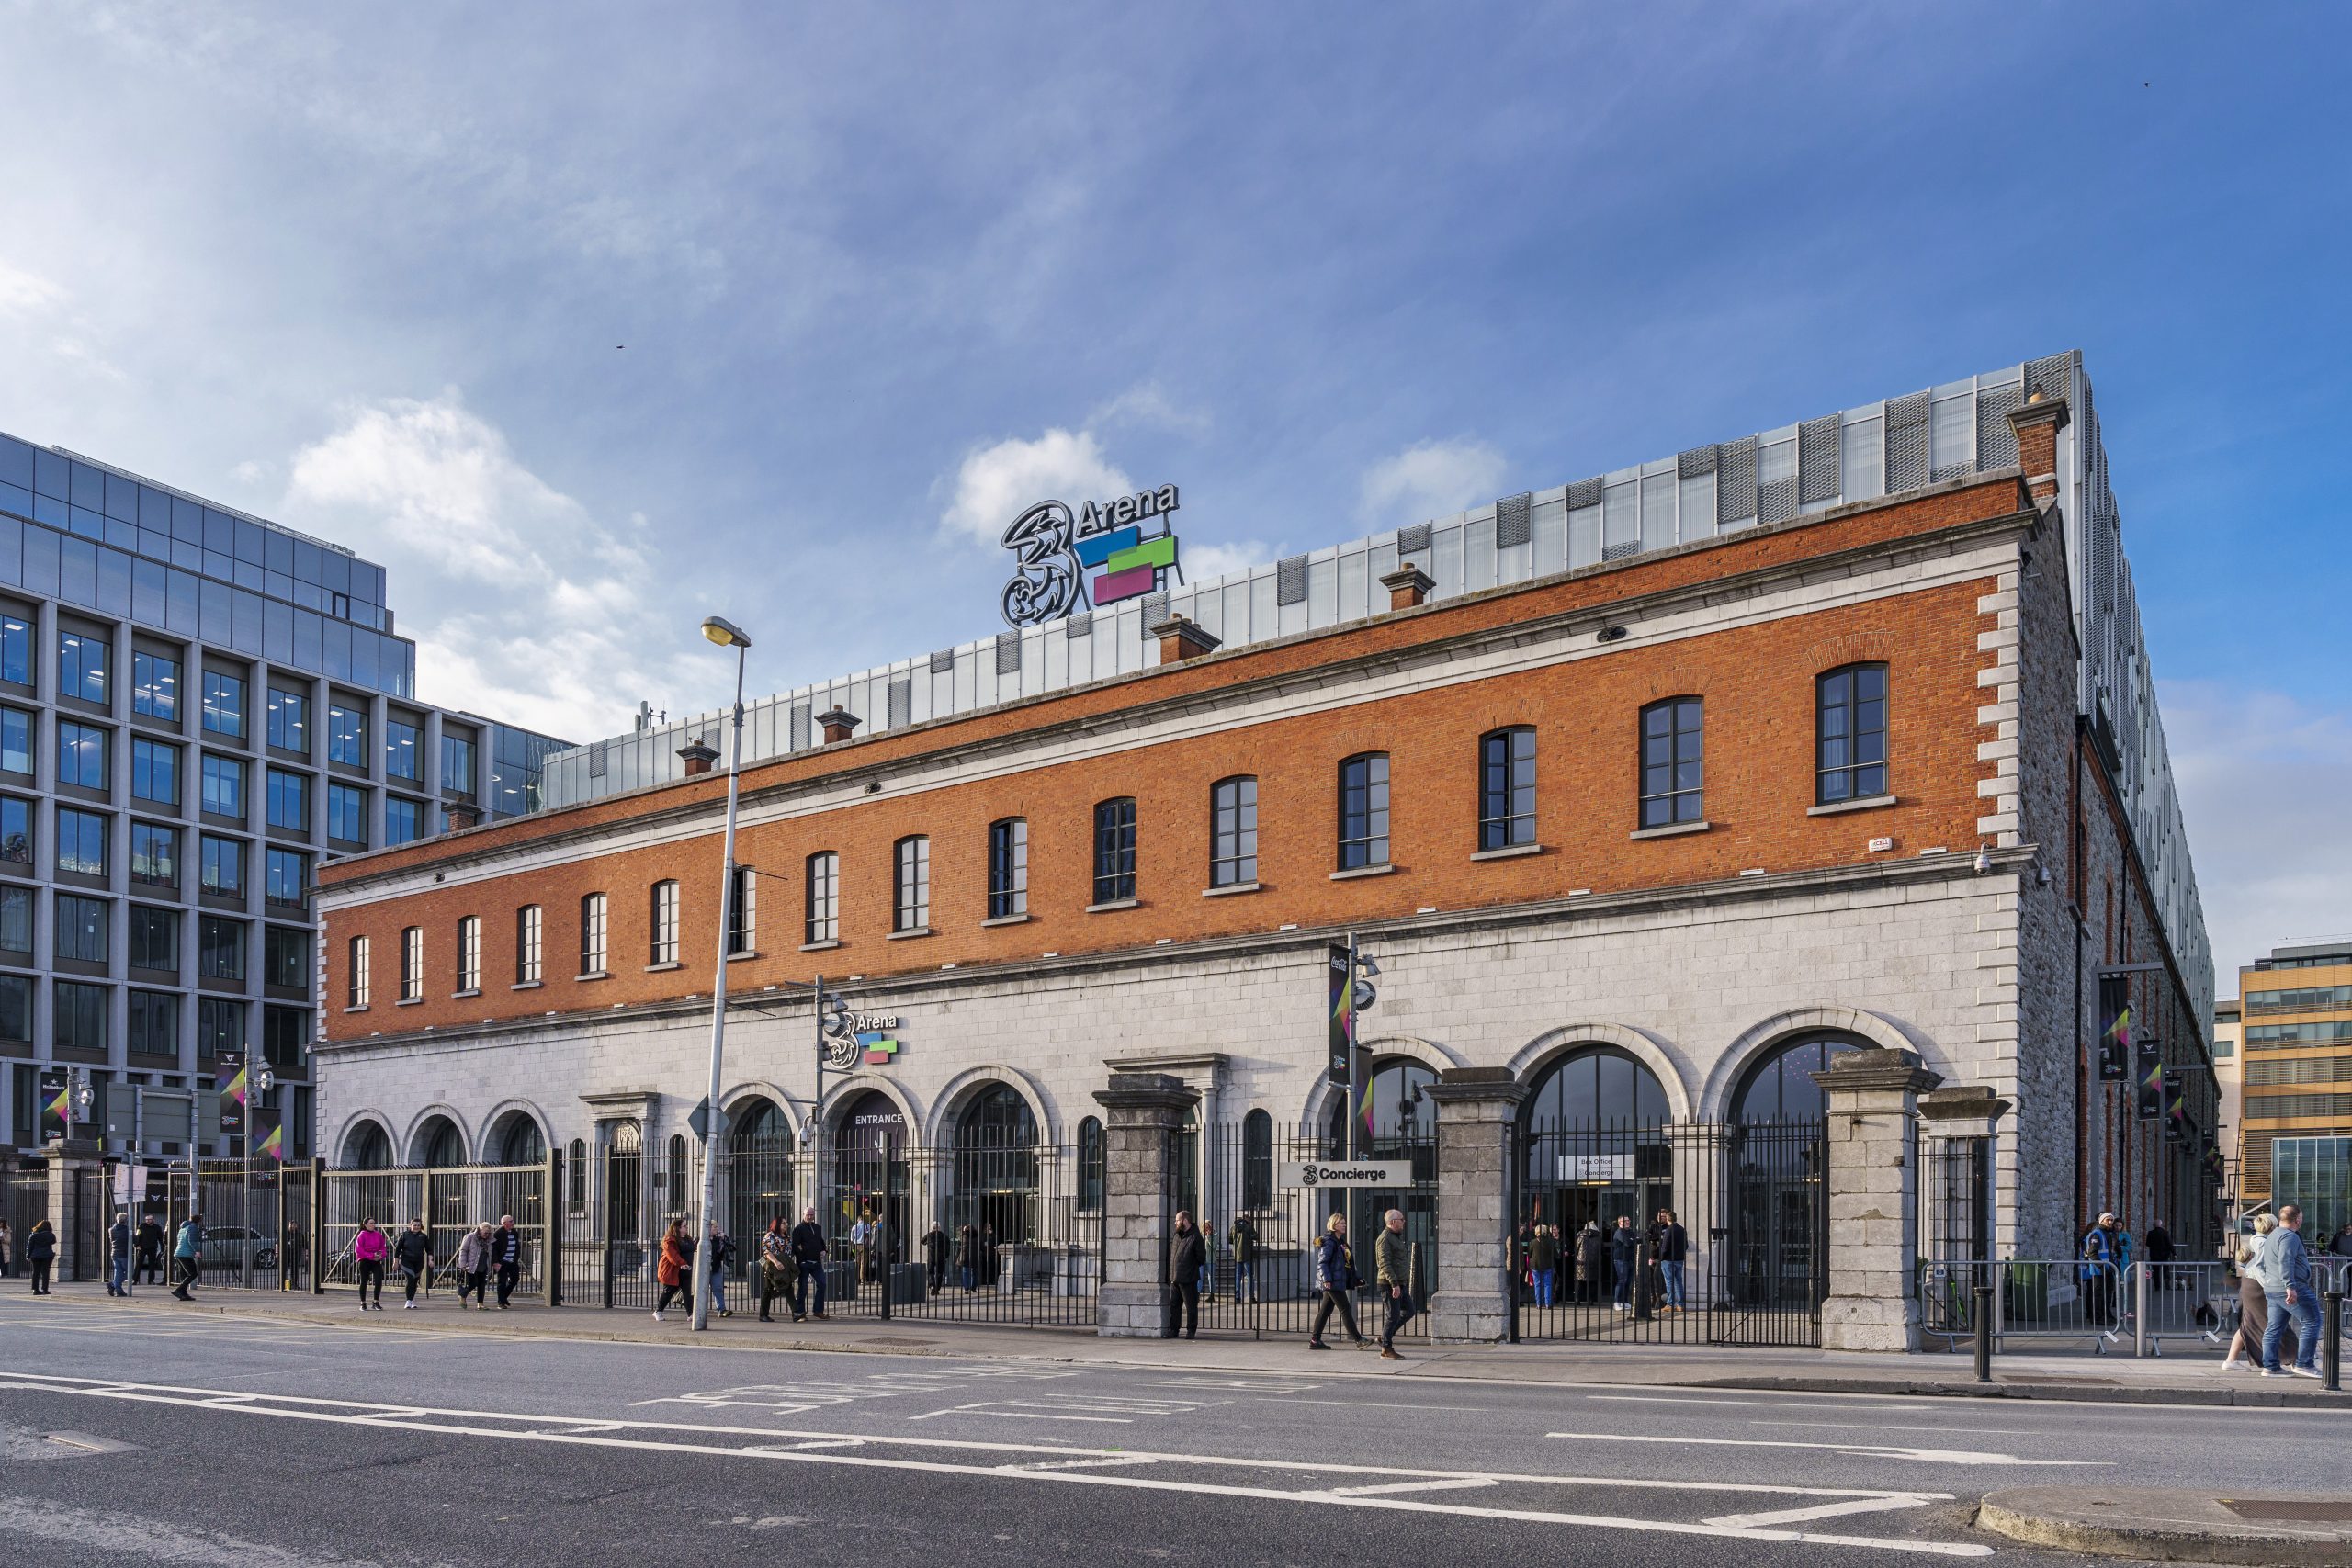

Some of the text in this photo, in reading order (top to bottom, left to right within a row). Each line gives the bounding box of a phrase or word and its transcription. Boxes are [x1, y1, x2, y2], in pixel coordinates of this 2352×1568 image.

[1075, 483, 1180, 537] Arena
[855, 1014, 898, 1031] Arena
[855, 1114, 903, 1125] ENTRANCE
[1319, 1168, 1386, 1182] Concierge
